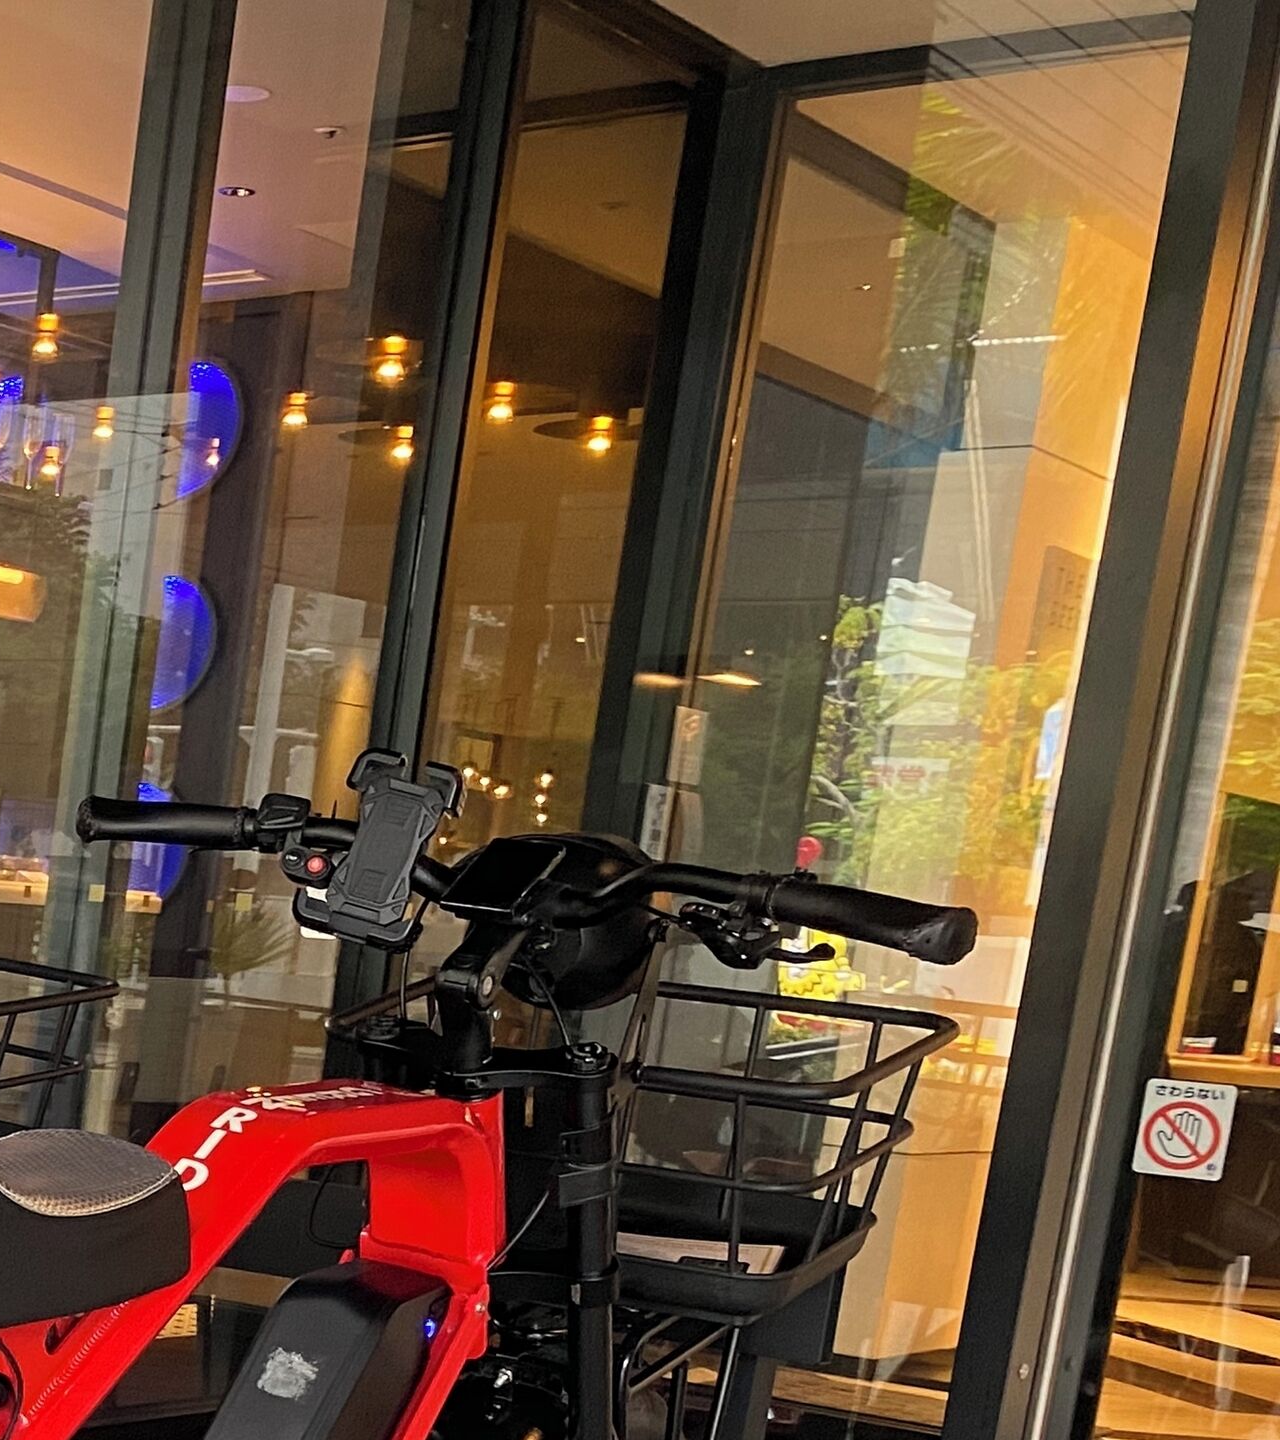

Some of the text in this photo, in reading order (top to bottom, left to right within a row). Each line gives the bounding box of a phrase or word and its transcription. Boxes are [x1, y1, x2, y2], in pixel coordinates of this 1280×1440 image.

[1155, 1085, 1226, 1100] さわらない
